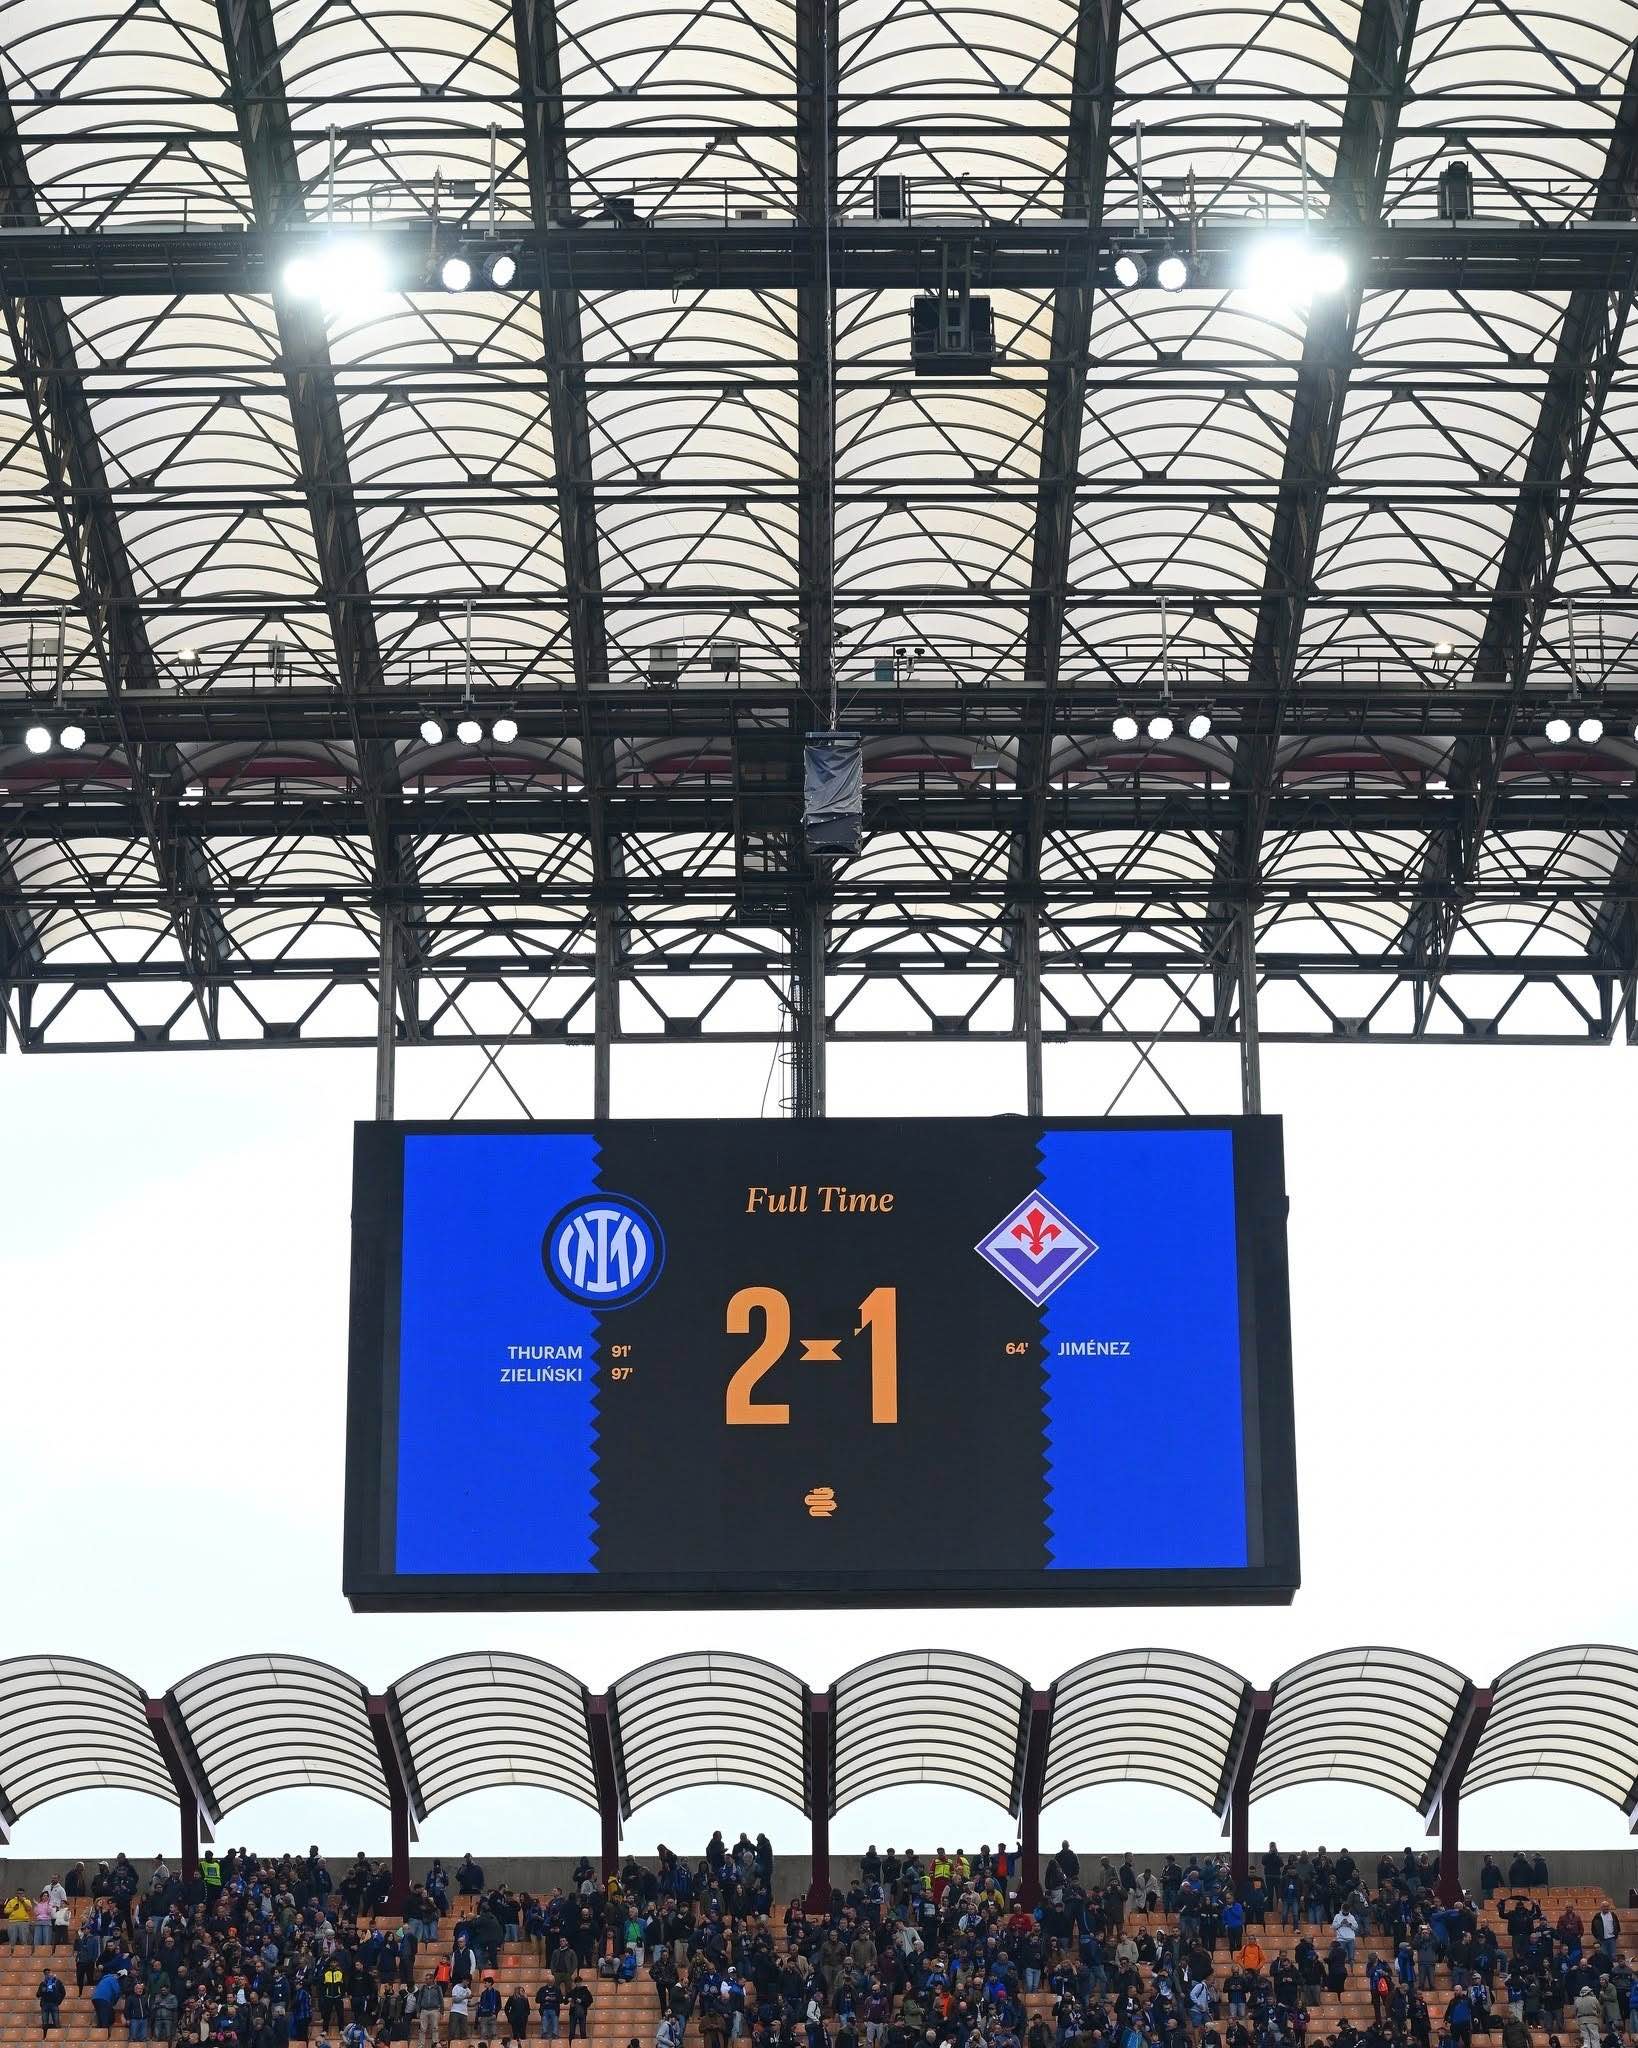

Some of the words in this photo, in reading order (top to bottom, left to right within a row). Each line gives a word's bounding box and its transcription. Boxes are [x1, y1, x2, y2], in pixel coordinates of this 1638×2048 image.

[745, 1185, 808, 1213] Full
[817, 1187, 894, 1213] Time
[507, 1345, 583, 1360] THURAM
[611, 1345, 632, 1358] 91'
[1005, 1342, 1029, 1355] 64'
[1057, 1339, 1130, 1356] JIMÉNEZ
[500, 1365, 582, 1382] ZIELIŃSKI
[611, 1367, 633, 1380] 97'
